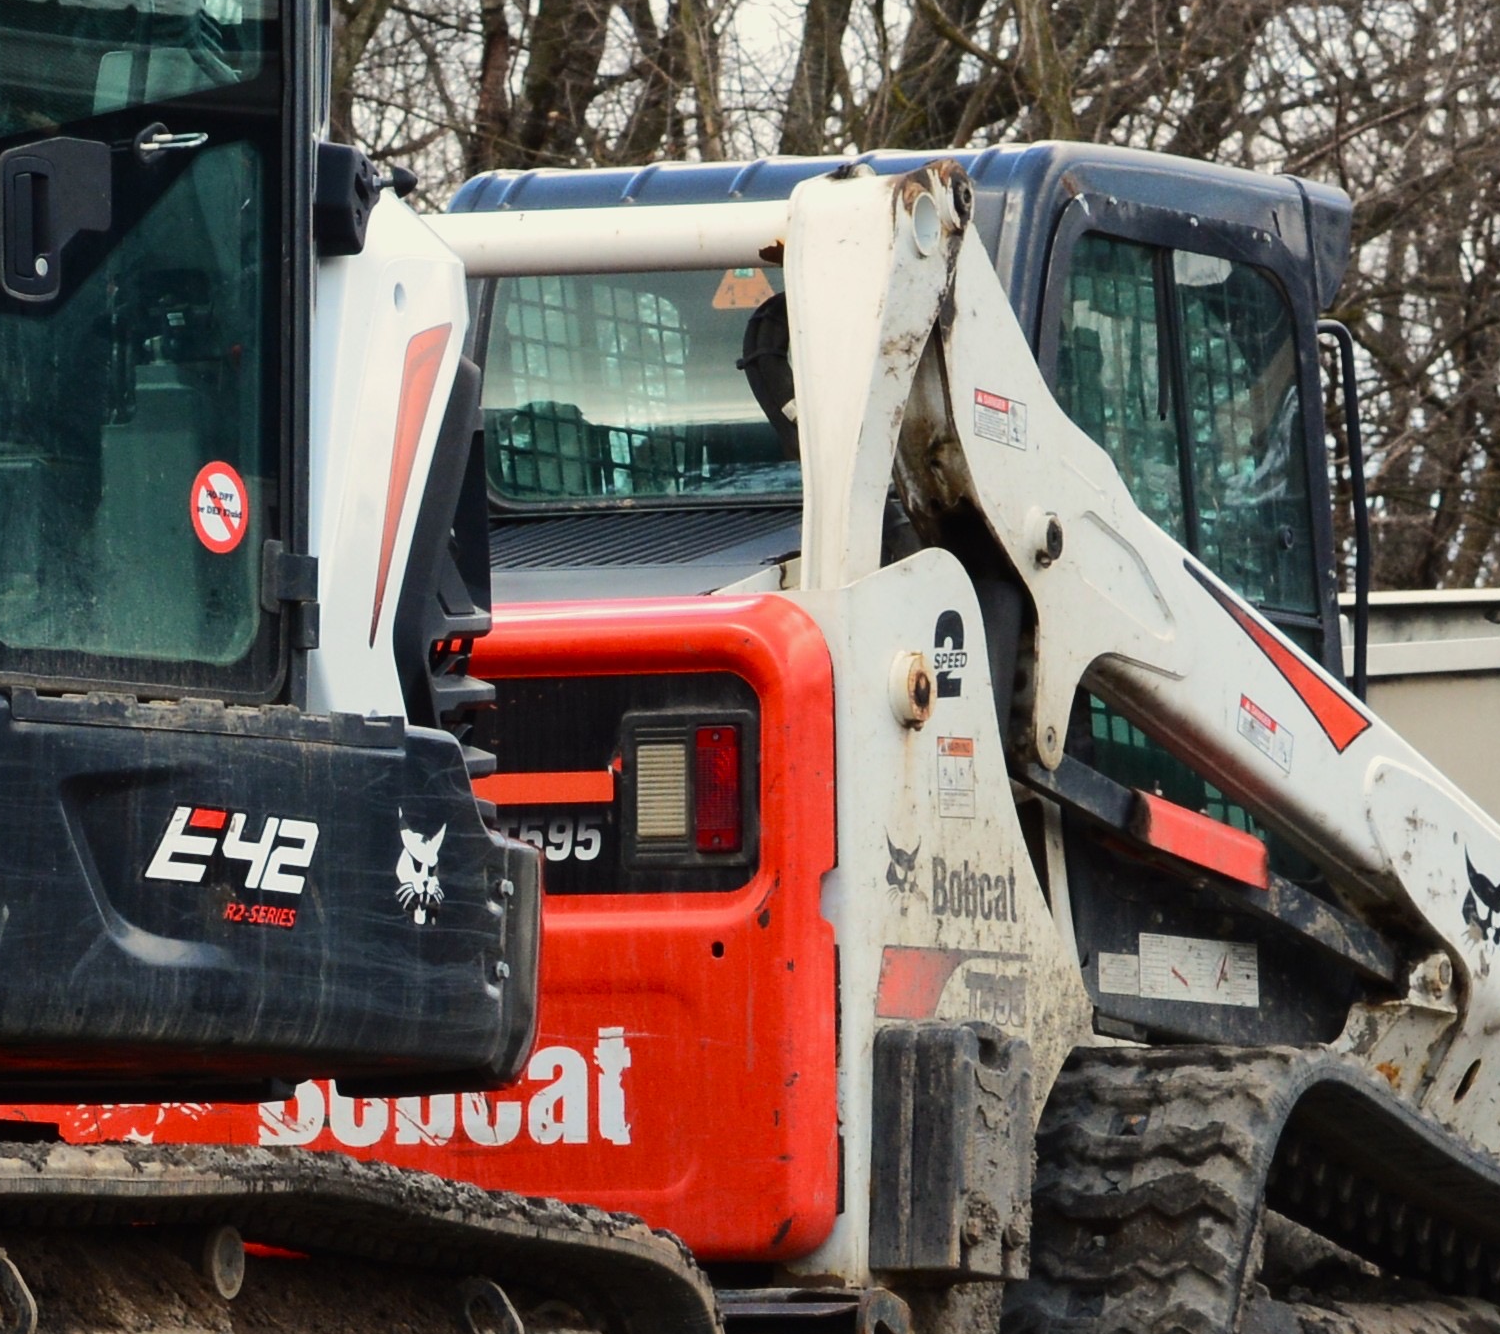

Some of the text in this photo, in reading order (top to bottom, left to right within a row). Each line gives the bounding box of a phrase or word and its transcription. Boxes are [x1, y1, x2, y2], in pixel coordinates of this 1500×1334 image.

[934, 652, 968, 670] SPEED
[144, 806, 320, 895] E42
[931, 855, 1018, 924] Bobcat
[223, 902, 297, 927] R2-SERIES
